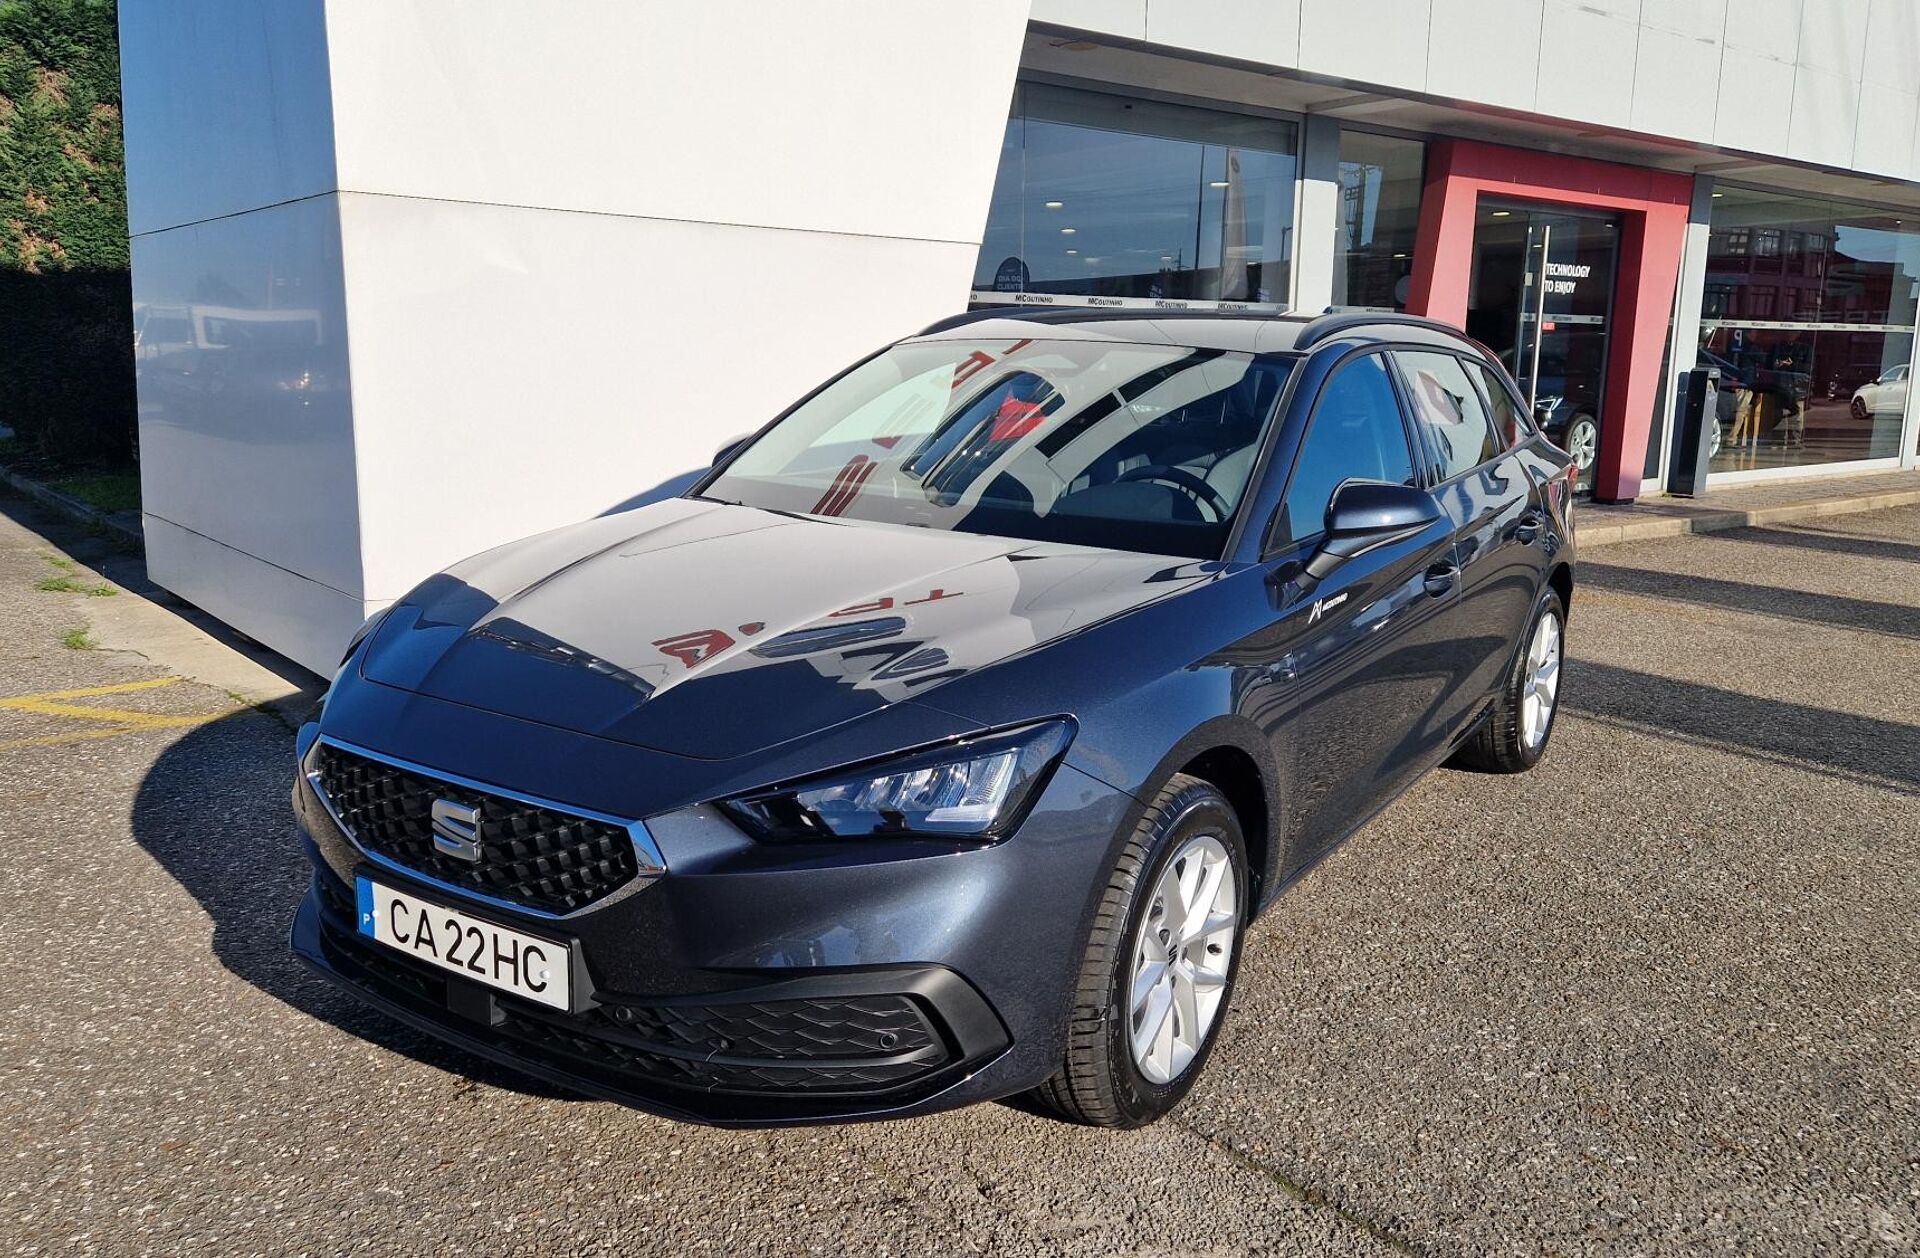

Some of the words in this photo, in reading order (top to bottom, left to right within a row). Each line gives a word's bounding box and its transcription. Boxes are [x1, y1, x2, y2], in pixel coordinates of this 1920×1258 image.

[1545, 263, 1591, 278] TECHNOLOGY
[1544, 280, 1554, 292] TO
[1554, 281, 1576, 295] ENJOY
[363, 913, 371, 925] P
